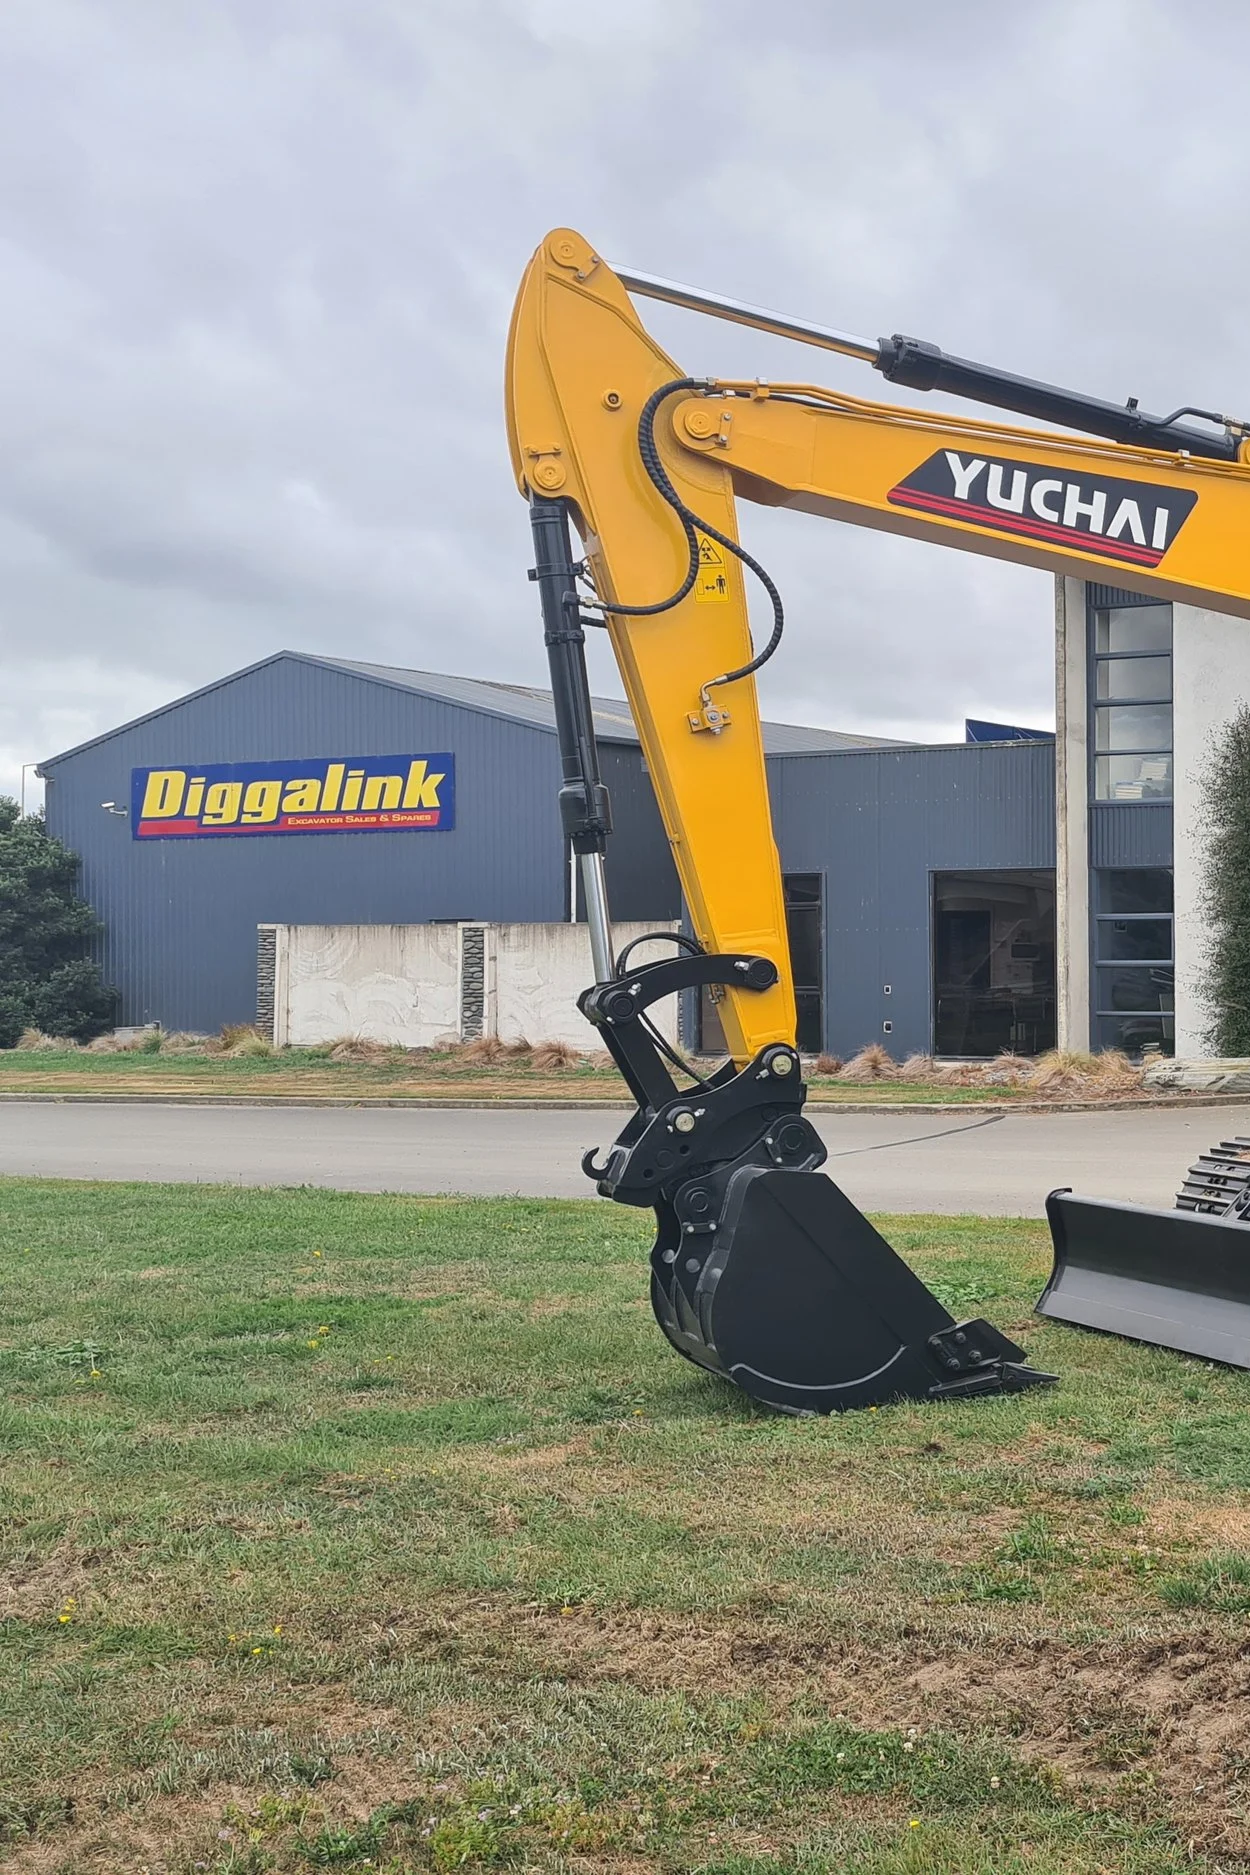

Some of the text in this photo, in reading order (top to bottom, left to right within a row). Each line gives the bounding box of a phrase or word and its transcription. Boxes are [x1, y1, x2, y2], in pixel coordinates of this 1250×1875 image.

[943, 451, 1170, 550] YUCHAI
[141, 760, 446, 825] Diggalink
[379, 814, 389, 822] &
